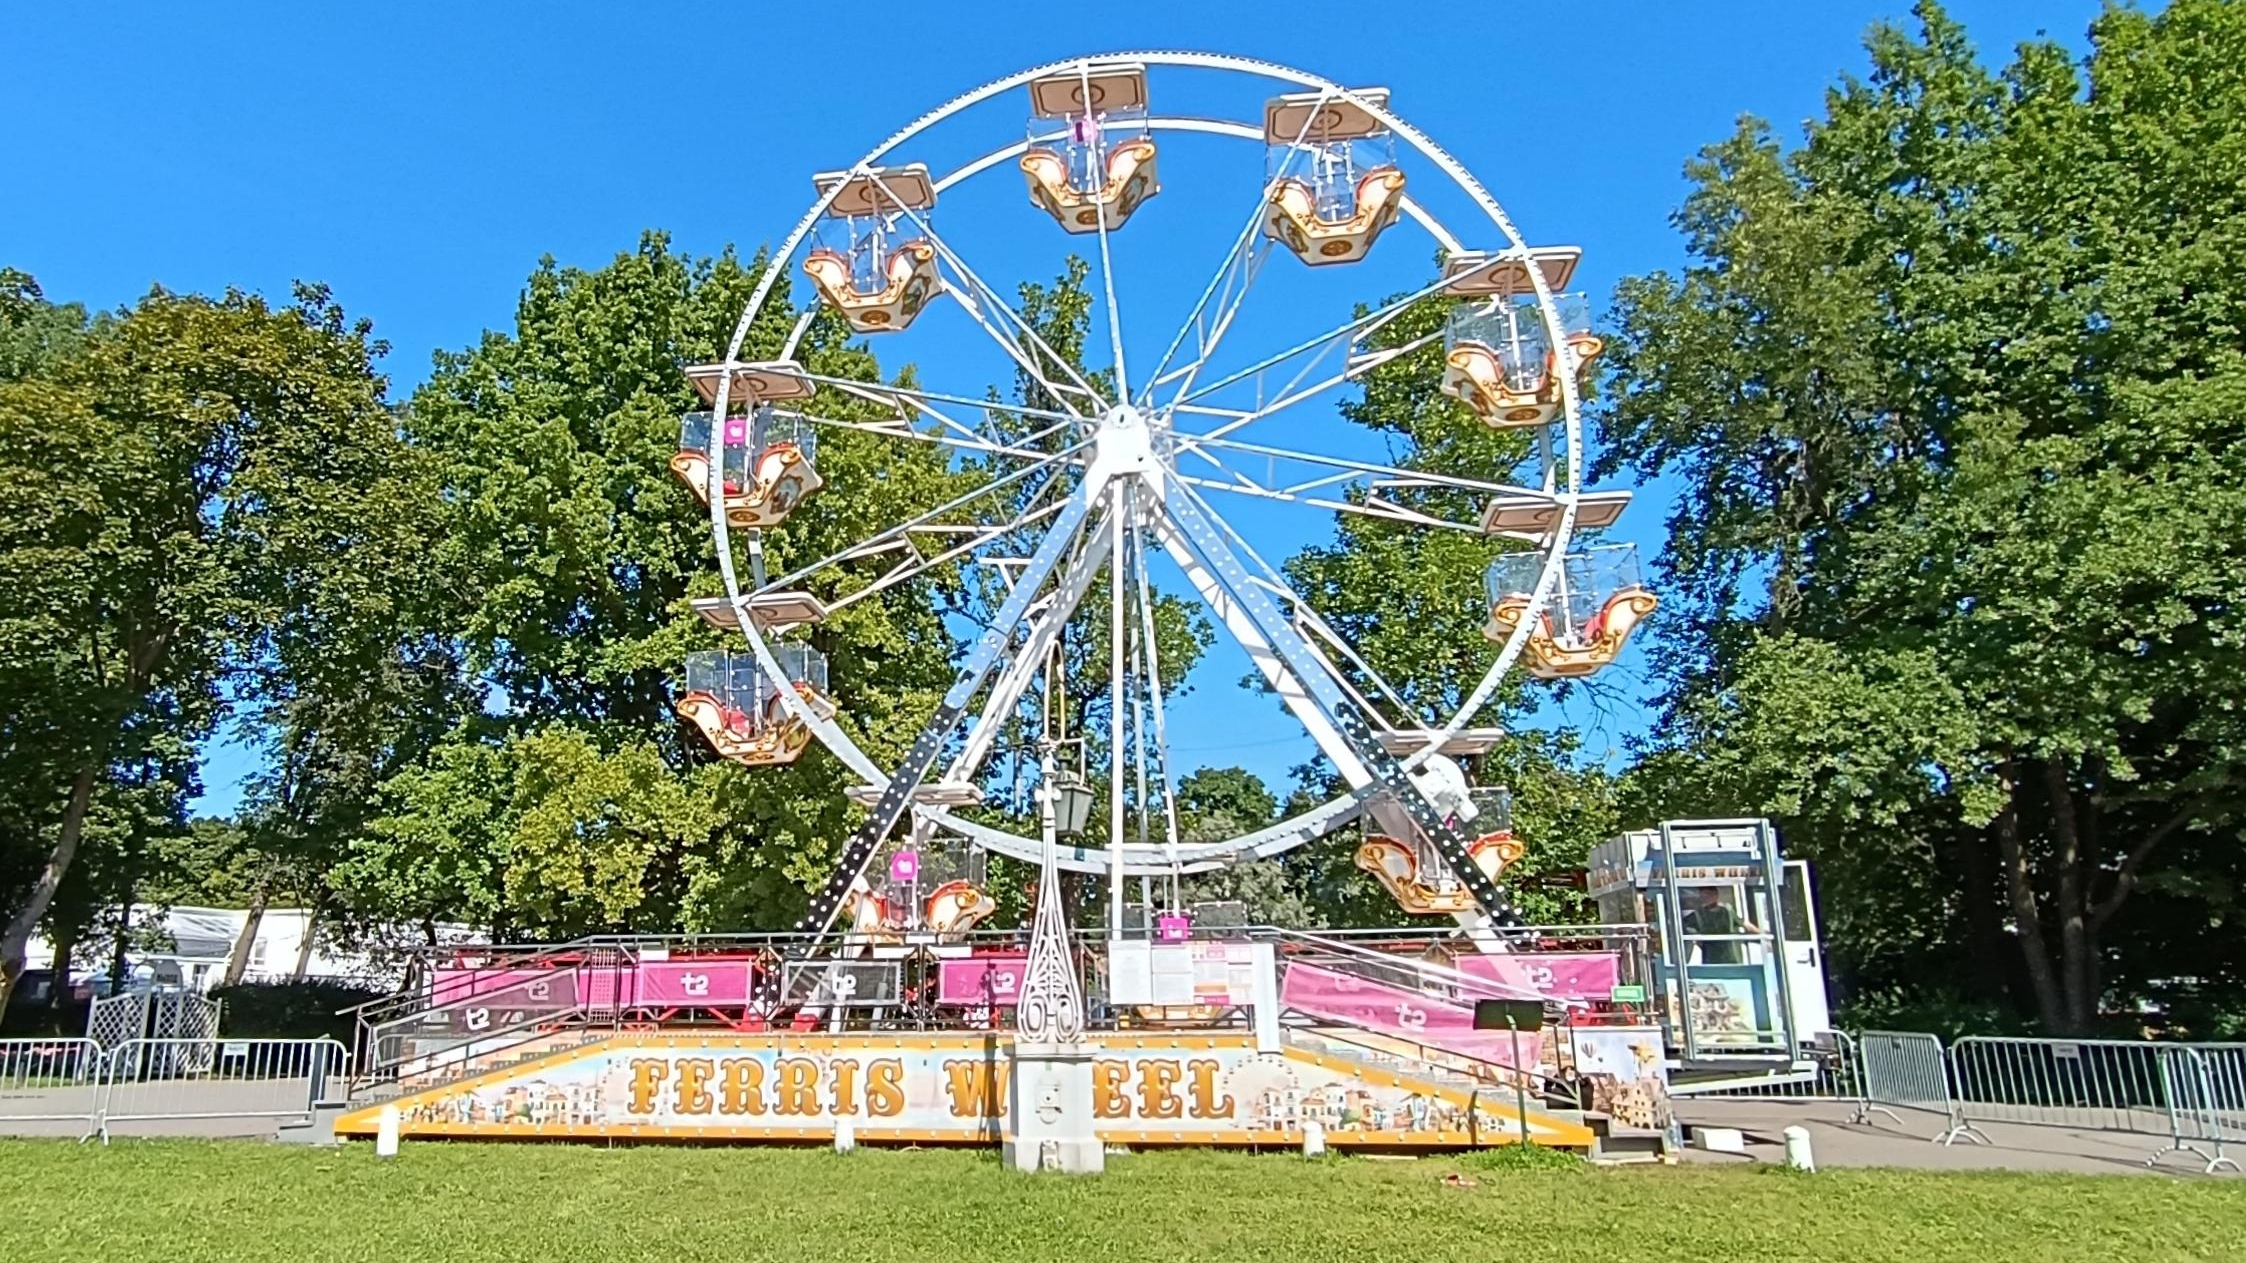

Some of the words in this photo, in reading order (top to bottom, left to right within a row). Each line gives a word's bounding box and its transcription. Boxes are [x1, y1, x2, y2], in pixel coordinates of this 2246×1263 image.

[680, 972, 709, 996] t2
[832, 971, 857, 995] t2
[1521, 965, 1553, 989] t2
[524, 981, 550, 1001] t2
[465, 1007, 490, 1031] t2
[1394, 1002, 1427, 1033] t2
[627, 1056, 906, 1118] FERRIS
[942, 1058, 1235, 1119] WEEL
